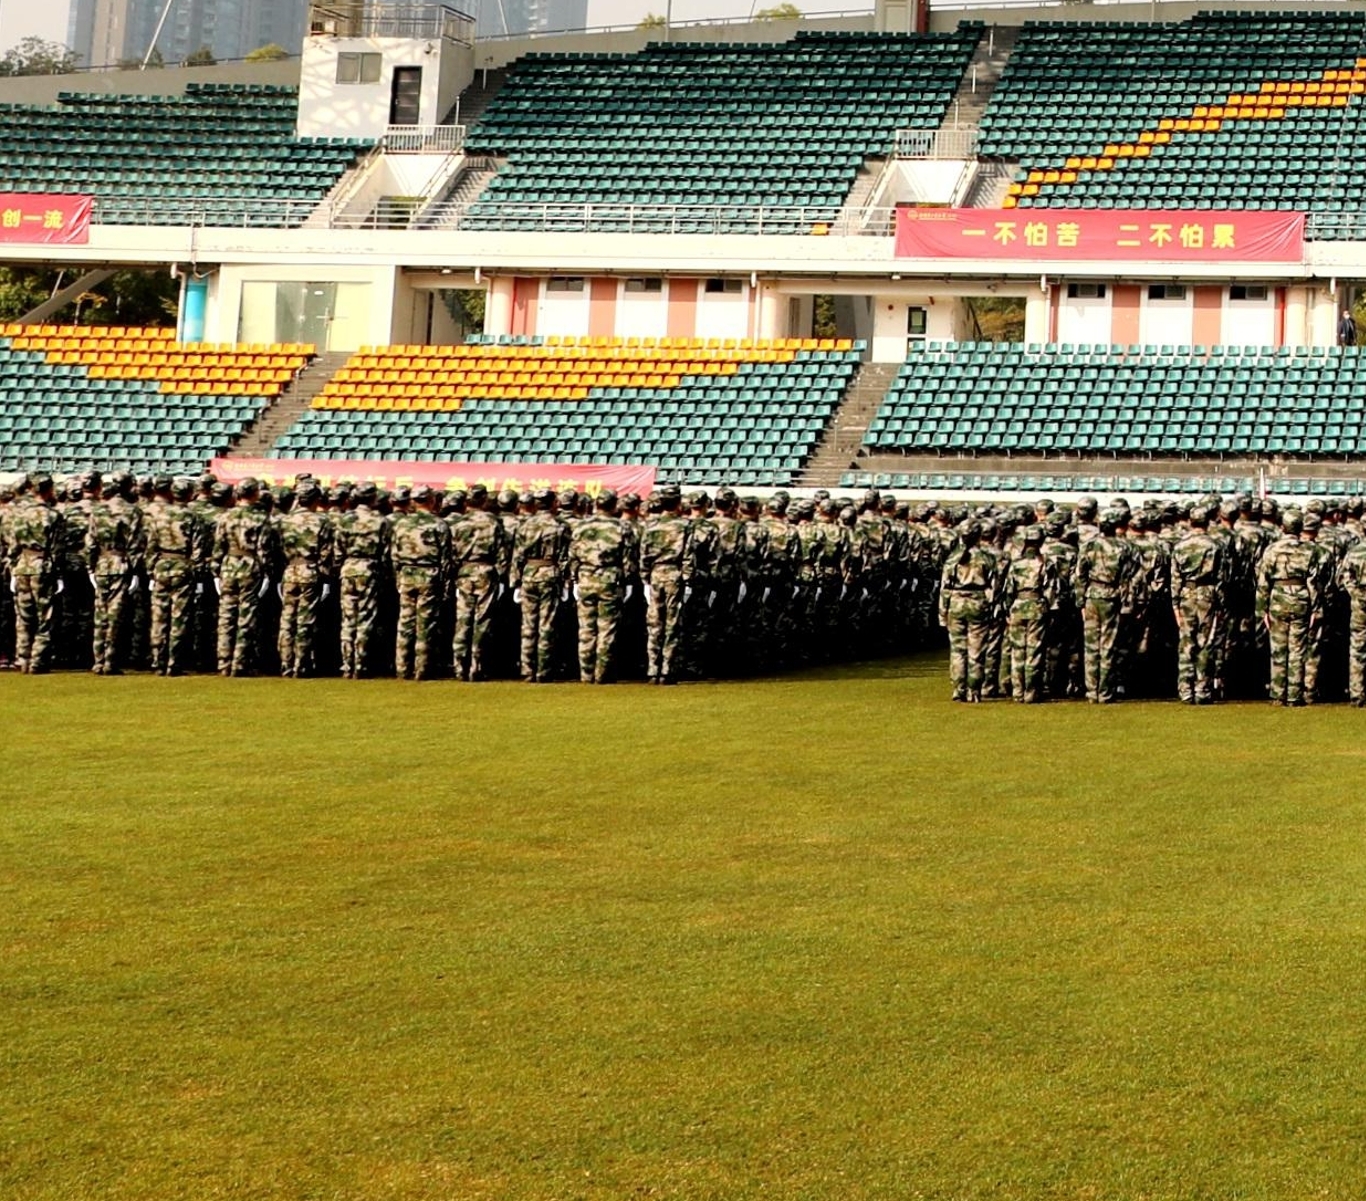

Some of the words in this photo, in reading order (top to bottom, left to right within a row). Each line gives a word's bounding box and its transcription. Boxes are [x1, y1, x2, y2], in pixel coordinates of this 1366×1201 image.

[2, 208, 64, 229] 创一流
[961, 221, 1081, 248] 一不怕苦
[1116, 223, 1236, 249] 二不怕累
